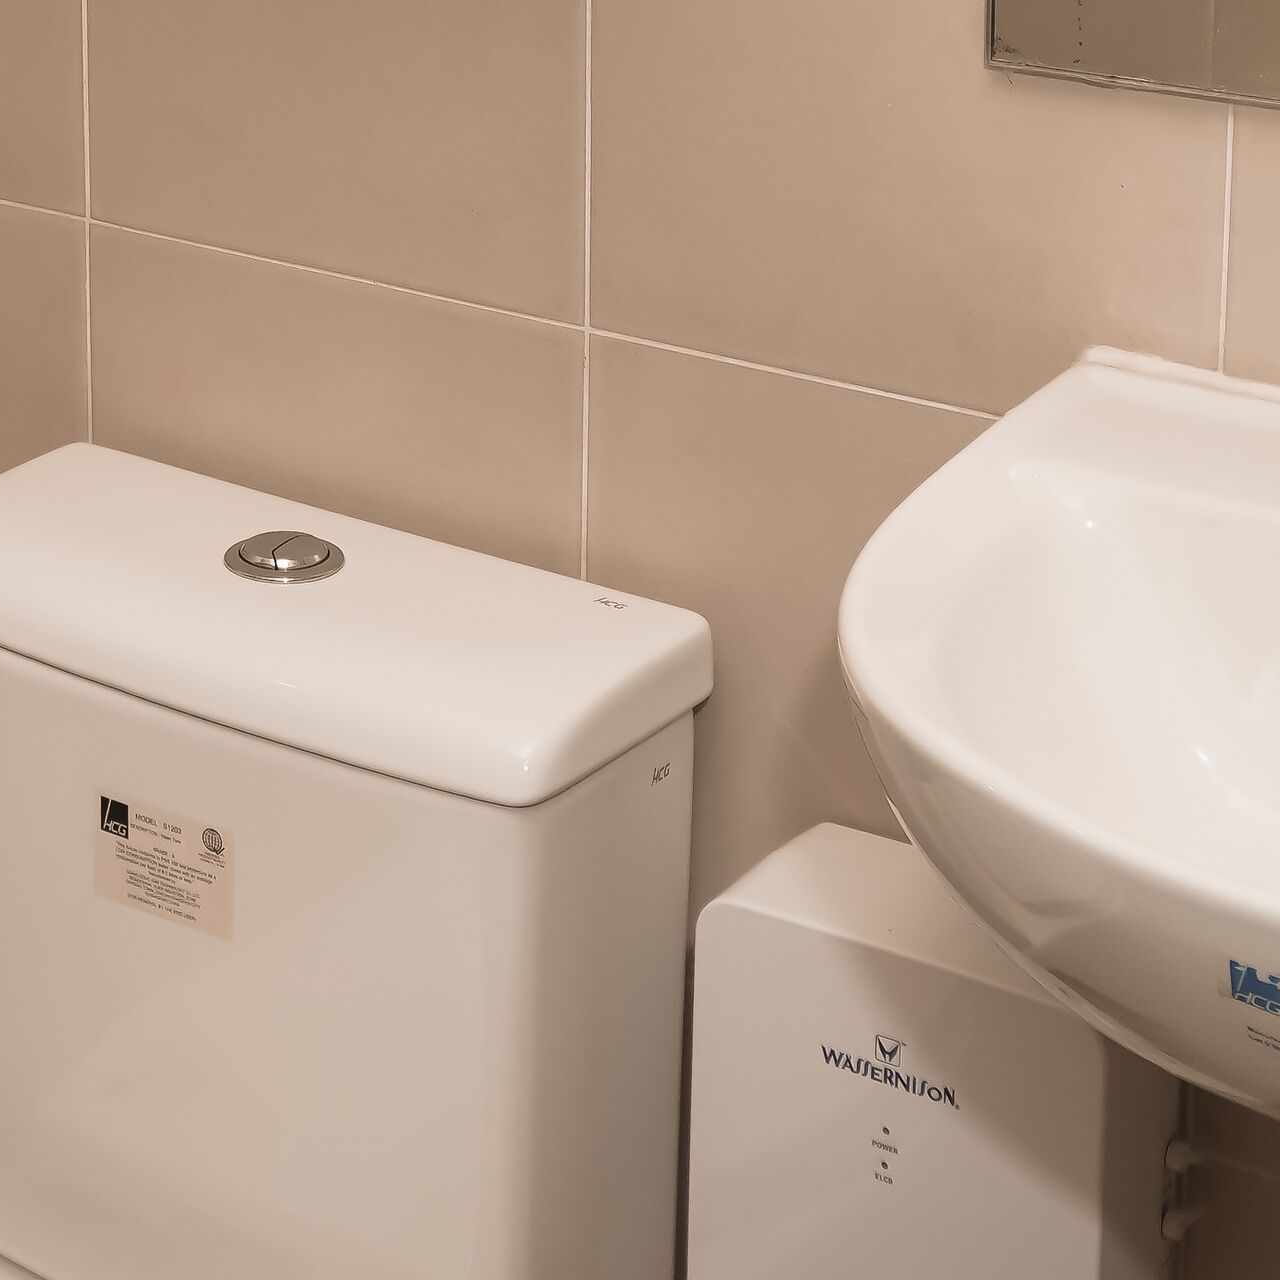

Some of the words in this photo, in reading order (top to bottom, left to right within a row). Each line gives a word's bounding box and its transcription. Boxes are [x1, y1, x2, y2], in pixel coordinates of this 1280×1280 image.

[593, 597, 628, 610] HCG
[652, 763, 670, 787] HCG
[135, 813, 158, 827] MODEL
[872, 1139, 898, 1155] POWER
